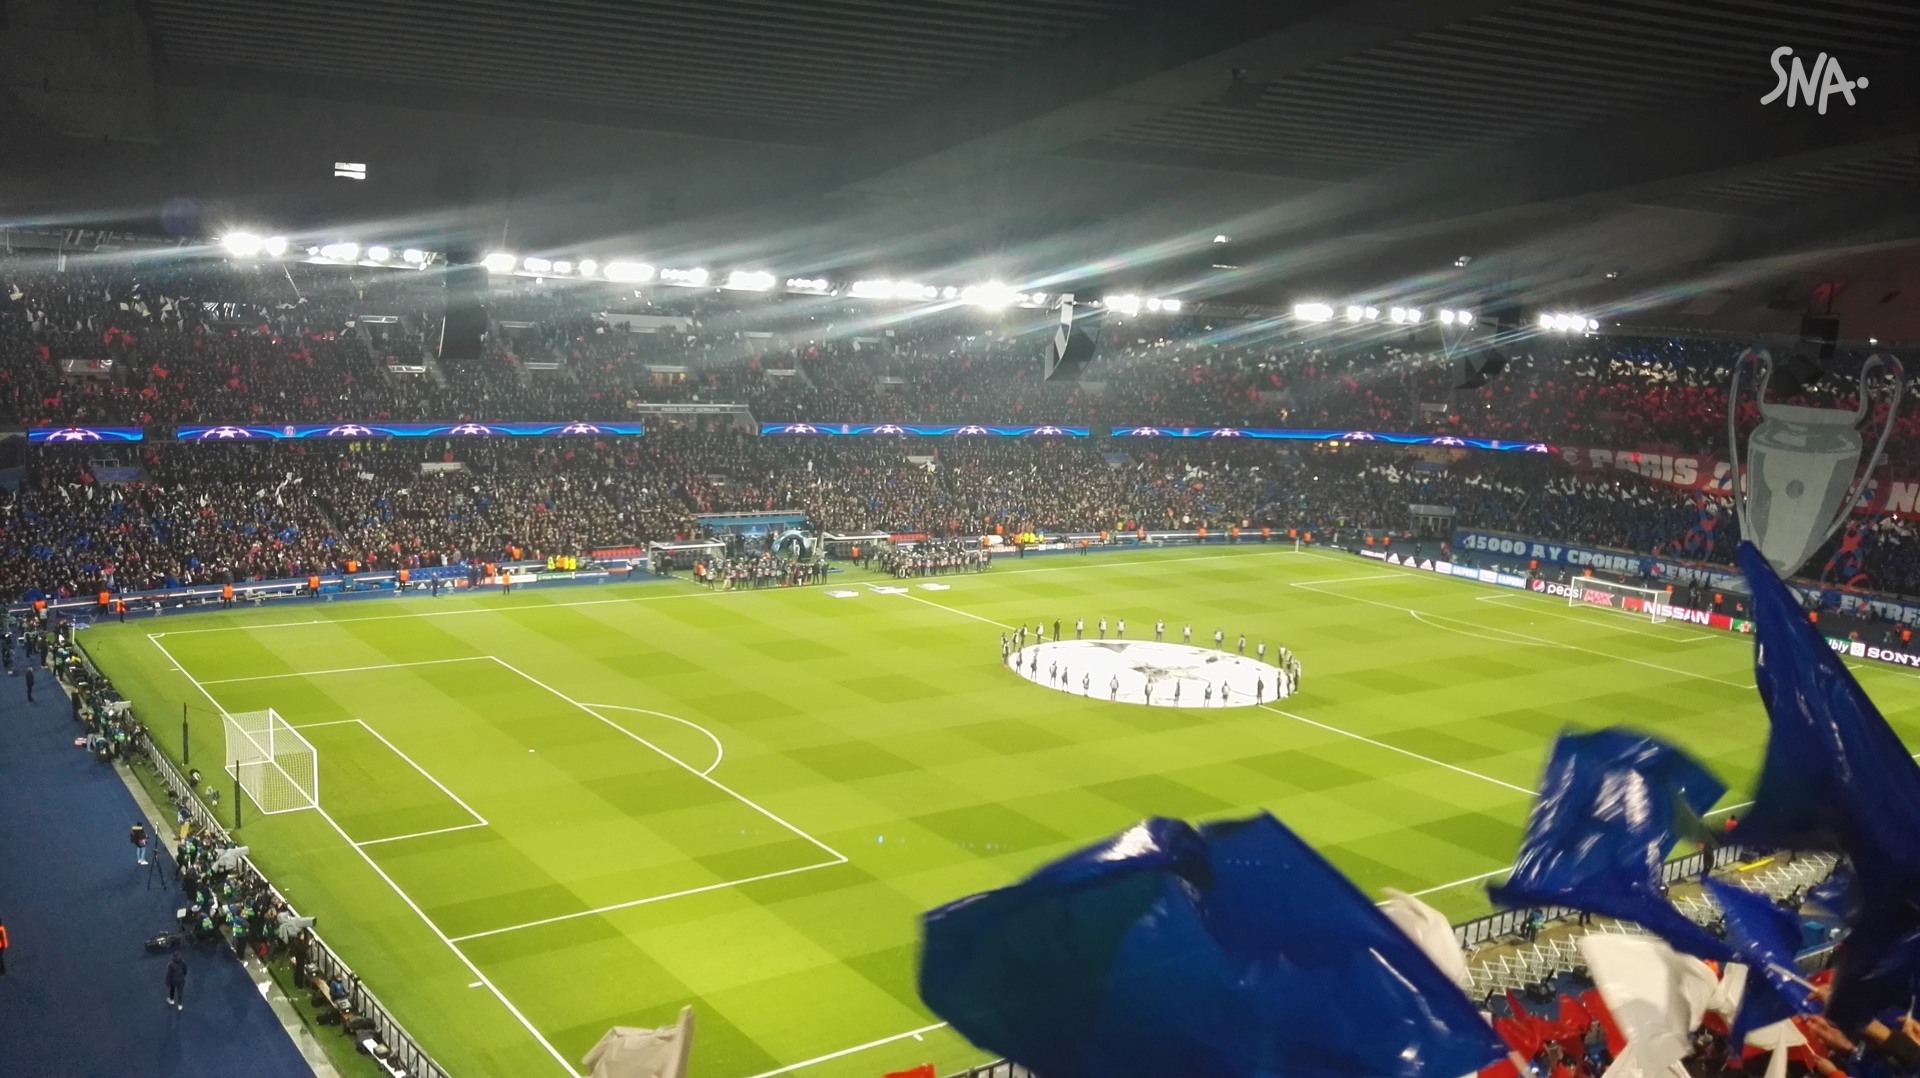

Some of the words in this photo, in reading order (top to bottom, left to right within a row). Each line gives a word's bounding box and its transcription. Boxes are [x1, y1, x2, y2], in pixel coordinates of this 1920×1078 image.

[1589, 448, 1699, 486] PARIS
[1549, 547, 1562, 561] Y
[1547, 583, 1583, 599] pepsi
[1584, 589, 1615, 606] MAX
[1643, 601, 1710, 625] NISSAN
[1867, 646, 1920, 667] SONY
